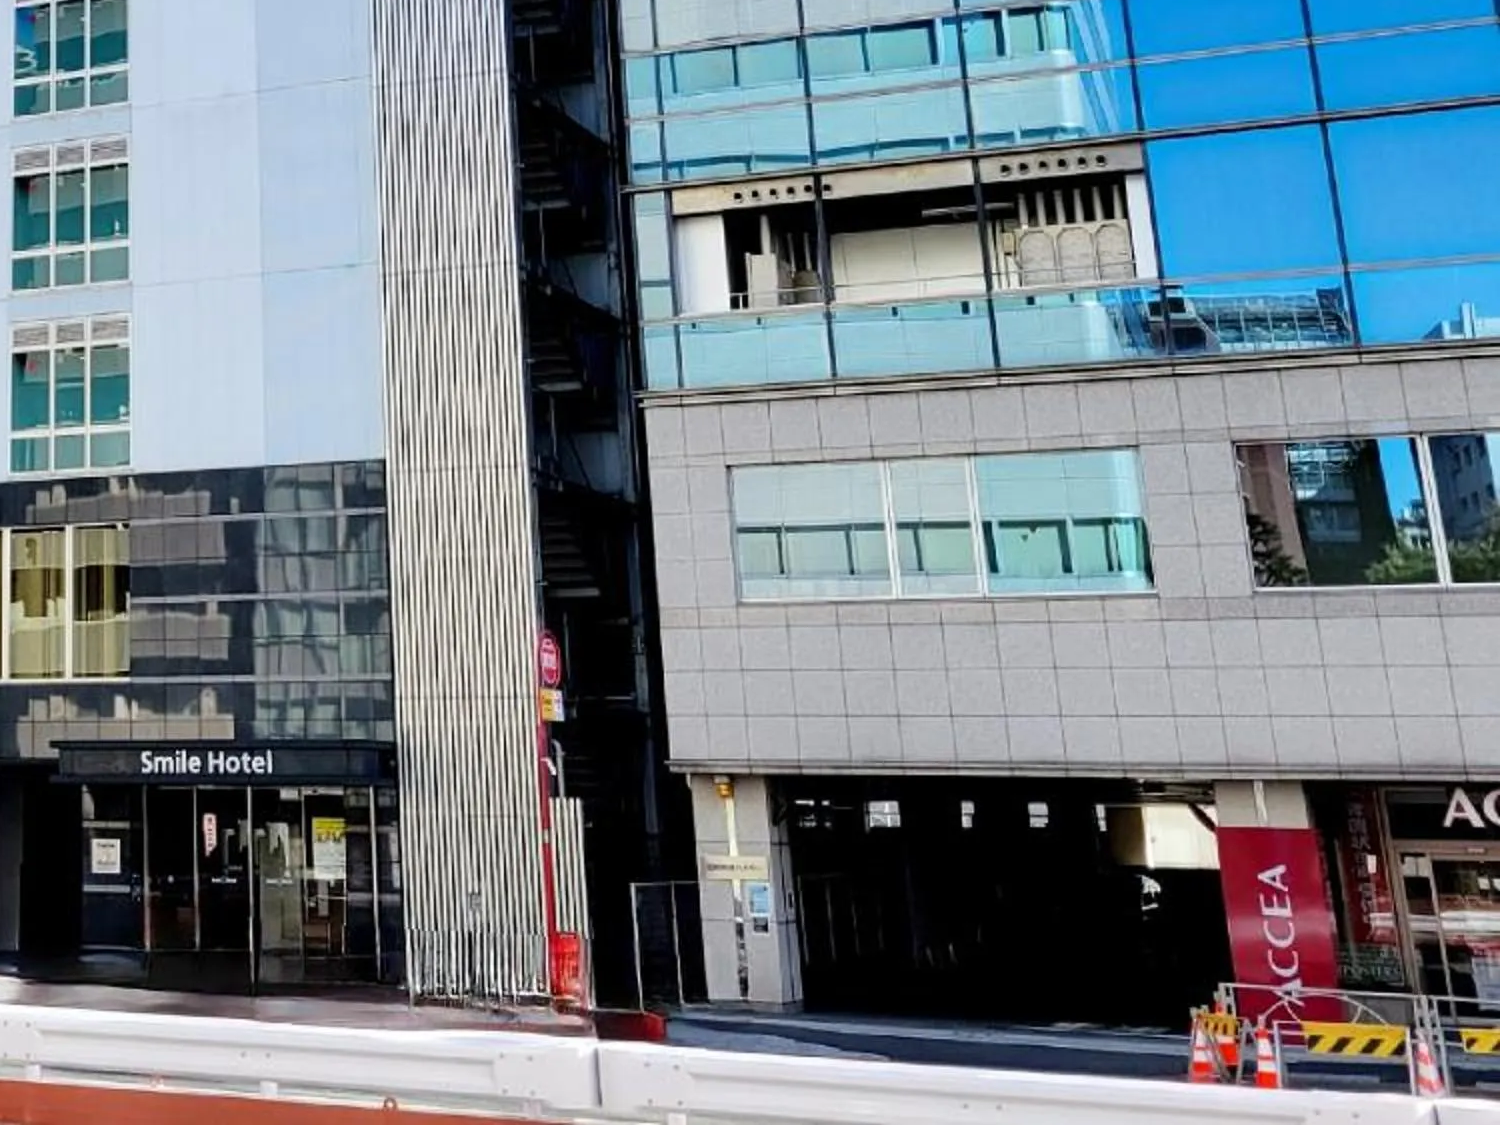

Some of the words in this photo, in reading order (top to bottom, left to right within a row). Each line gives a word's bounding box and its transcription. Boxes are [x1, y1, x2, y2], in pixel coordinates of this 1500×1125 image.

[140, 748, 202, 775] Smile
[207, 748, 273, 775] Hotel
[1257, 864, 1305, 1007] ACCEA
